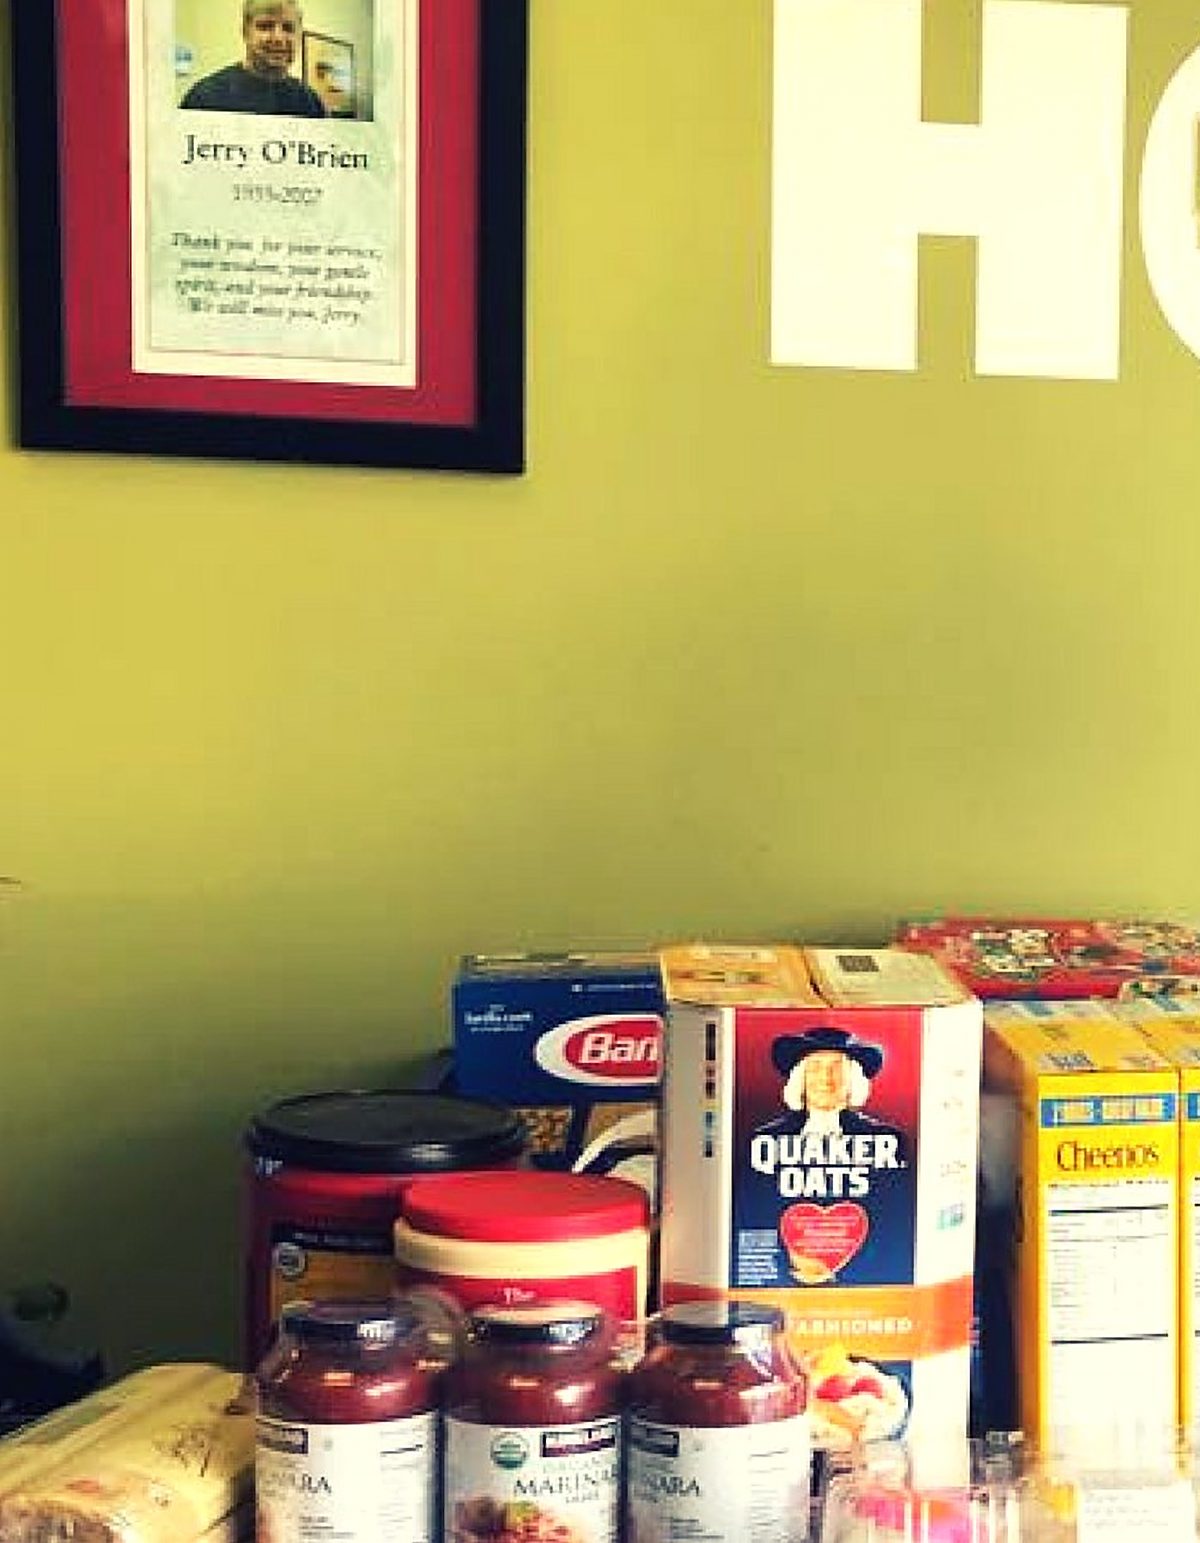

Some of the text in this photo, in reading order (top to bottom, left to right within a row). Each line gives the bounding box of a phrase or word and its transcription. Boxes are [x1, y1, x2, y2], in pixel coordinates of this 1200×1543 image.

[181, 135, 369, 169] Jerry O'Brien
[750, 1134, 900, 1175] QUAKER
[1056, 1141, 1160, 1172] Cheerios
[779, 1166, 871, 1199] OATS
